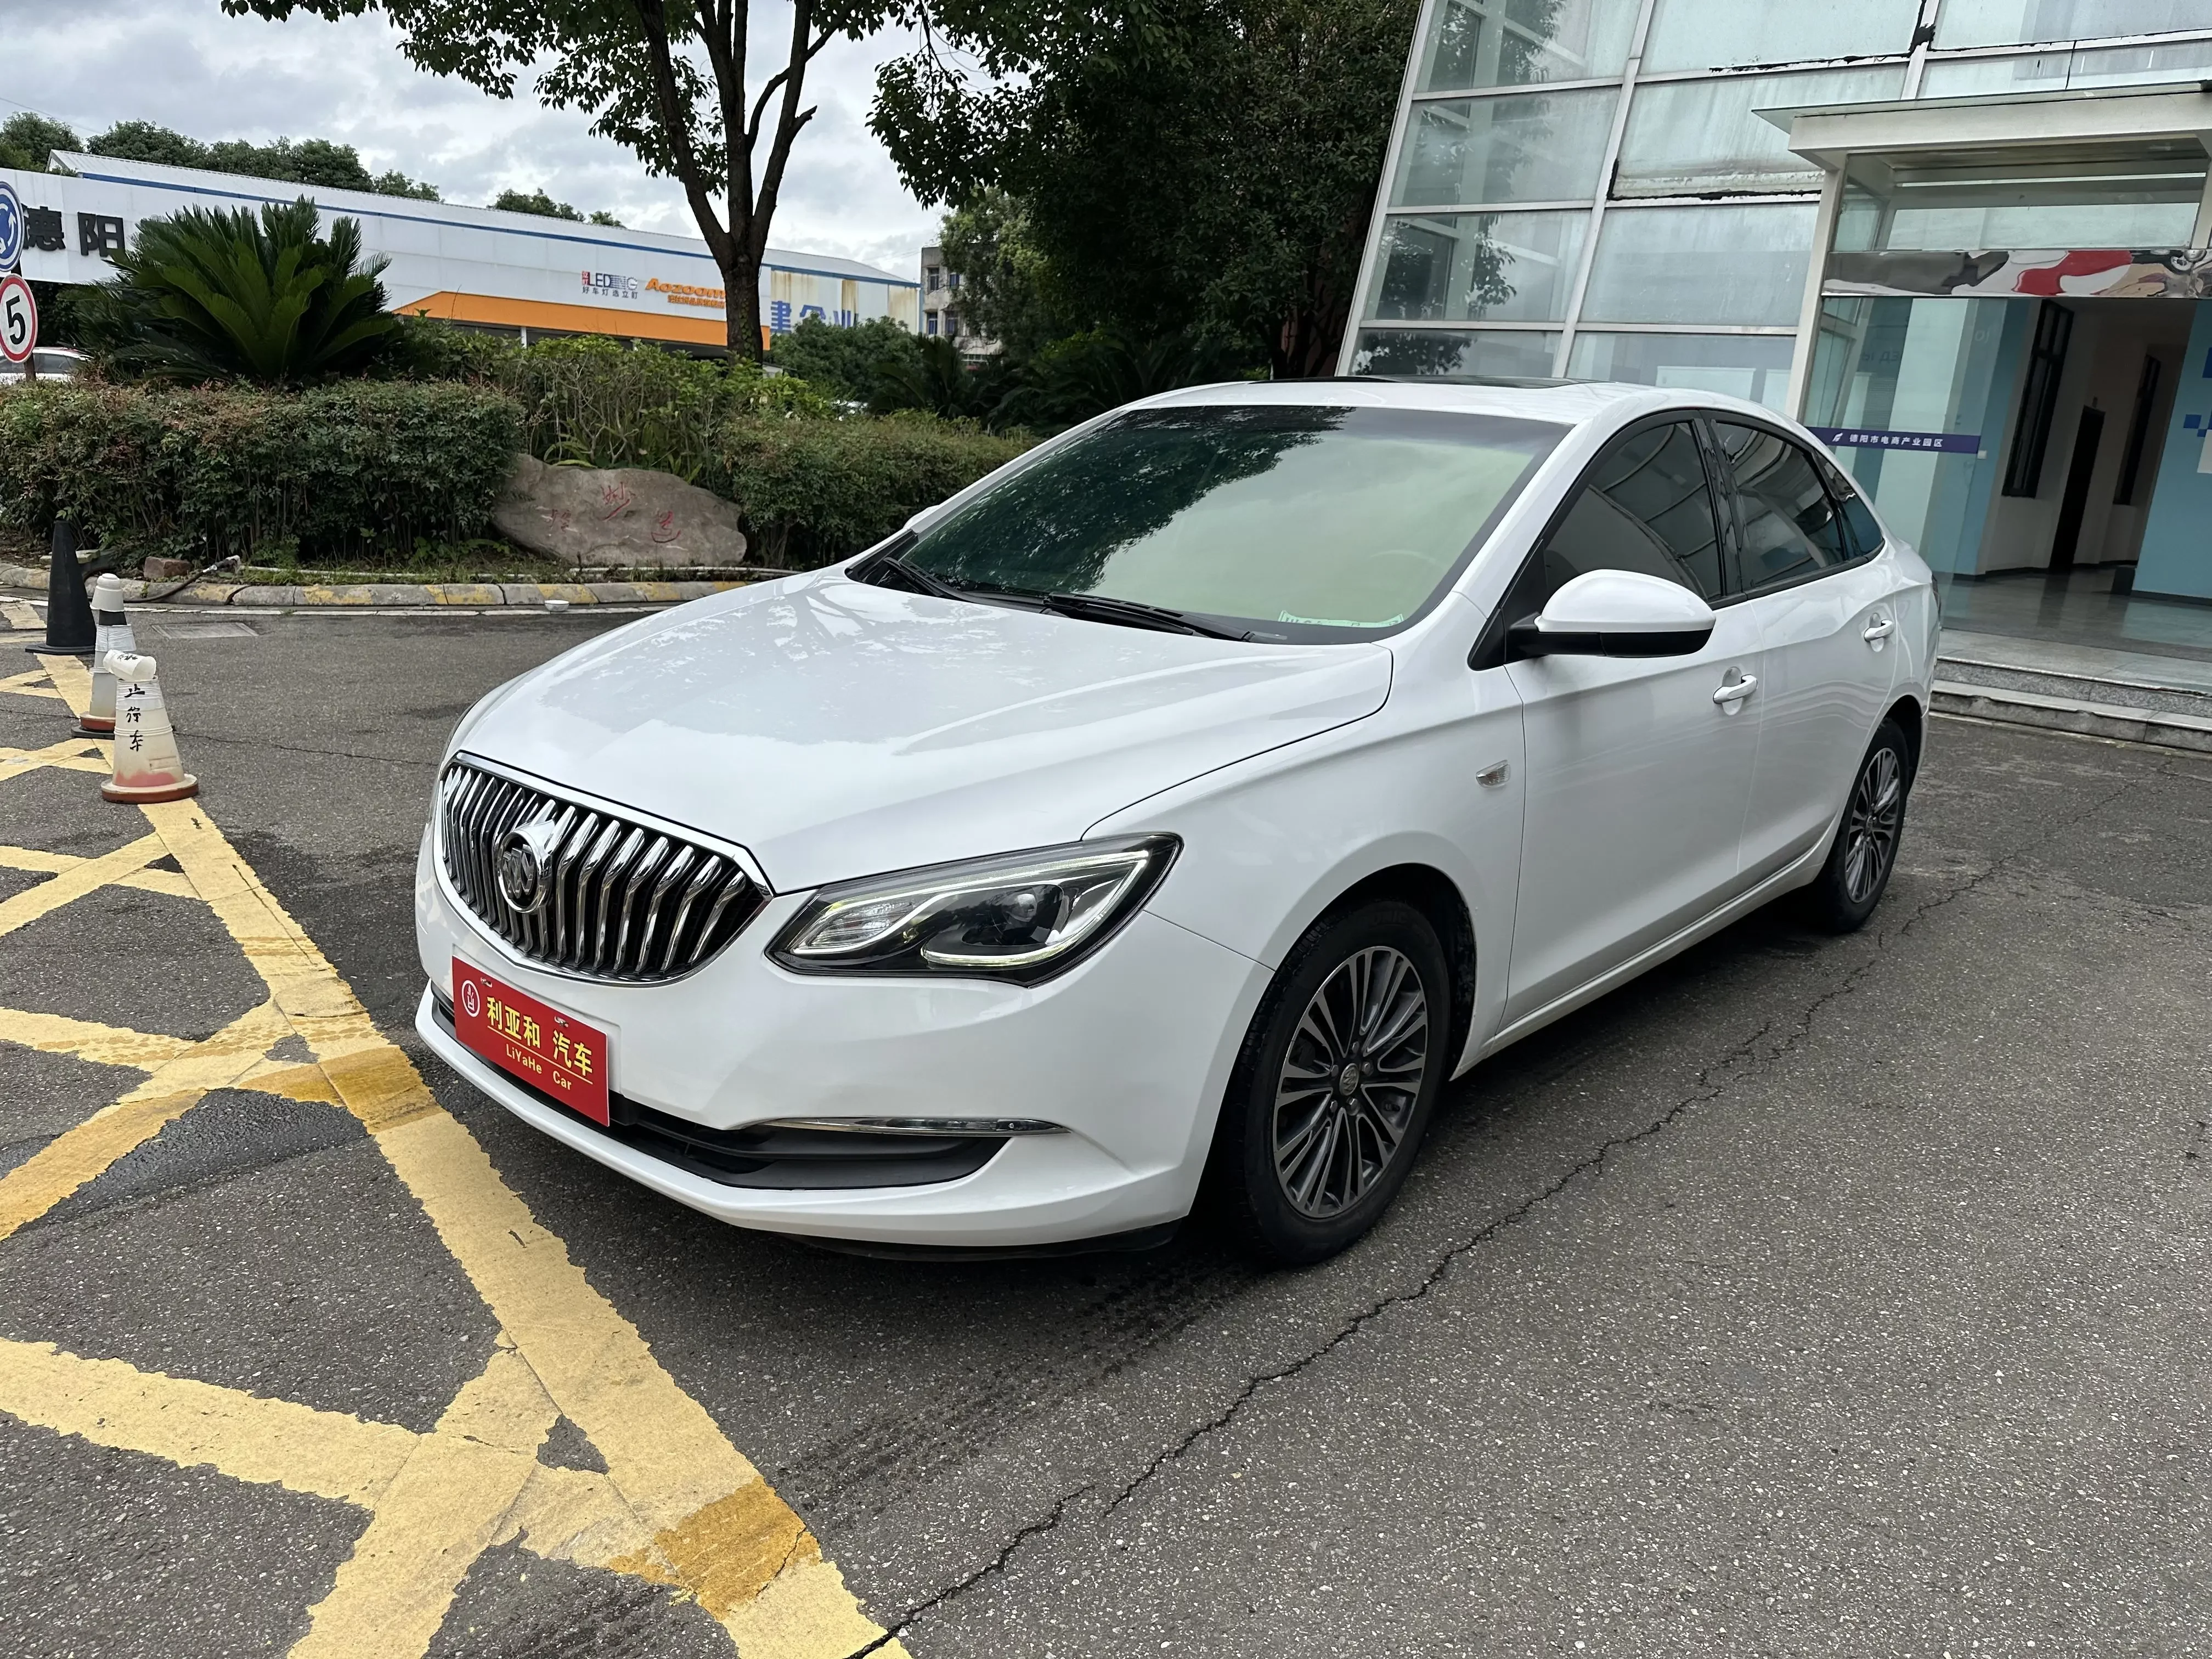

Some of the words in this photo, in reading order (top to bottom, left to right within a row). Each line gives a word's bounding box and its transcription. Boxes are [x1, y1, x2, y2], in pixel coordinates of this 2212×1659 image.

[645, 277, 725, 299] Aozoom
[6, 295, 26, 345] 5
[1849, 433, 1943, 447] 德阳市电商产业园区
[487, 996, 541, 1049] 利亚和
[552, 1030, 593, 1076] 汽车
[506, 1043, 542, 1075] LiYaHe
[552, 1070, 572, 1091] Car
